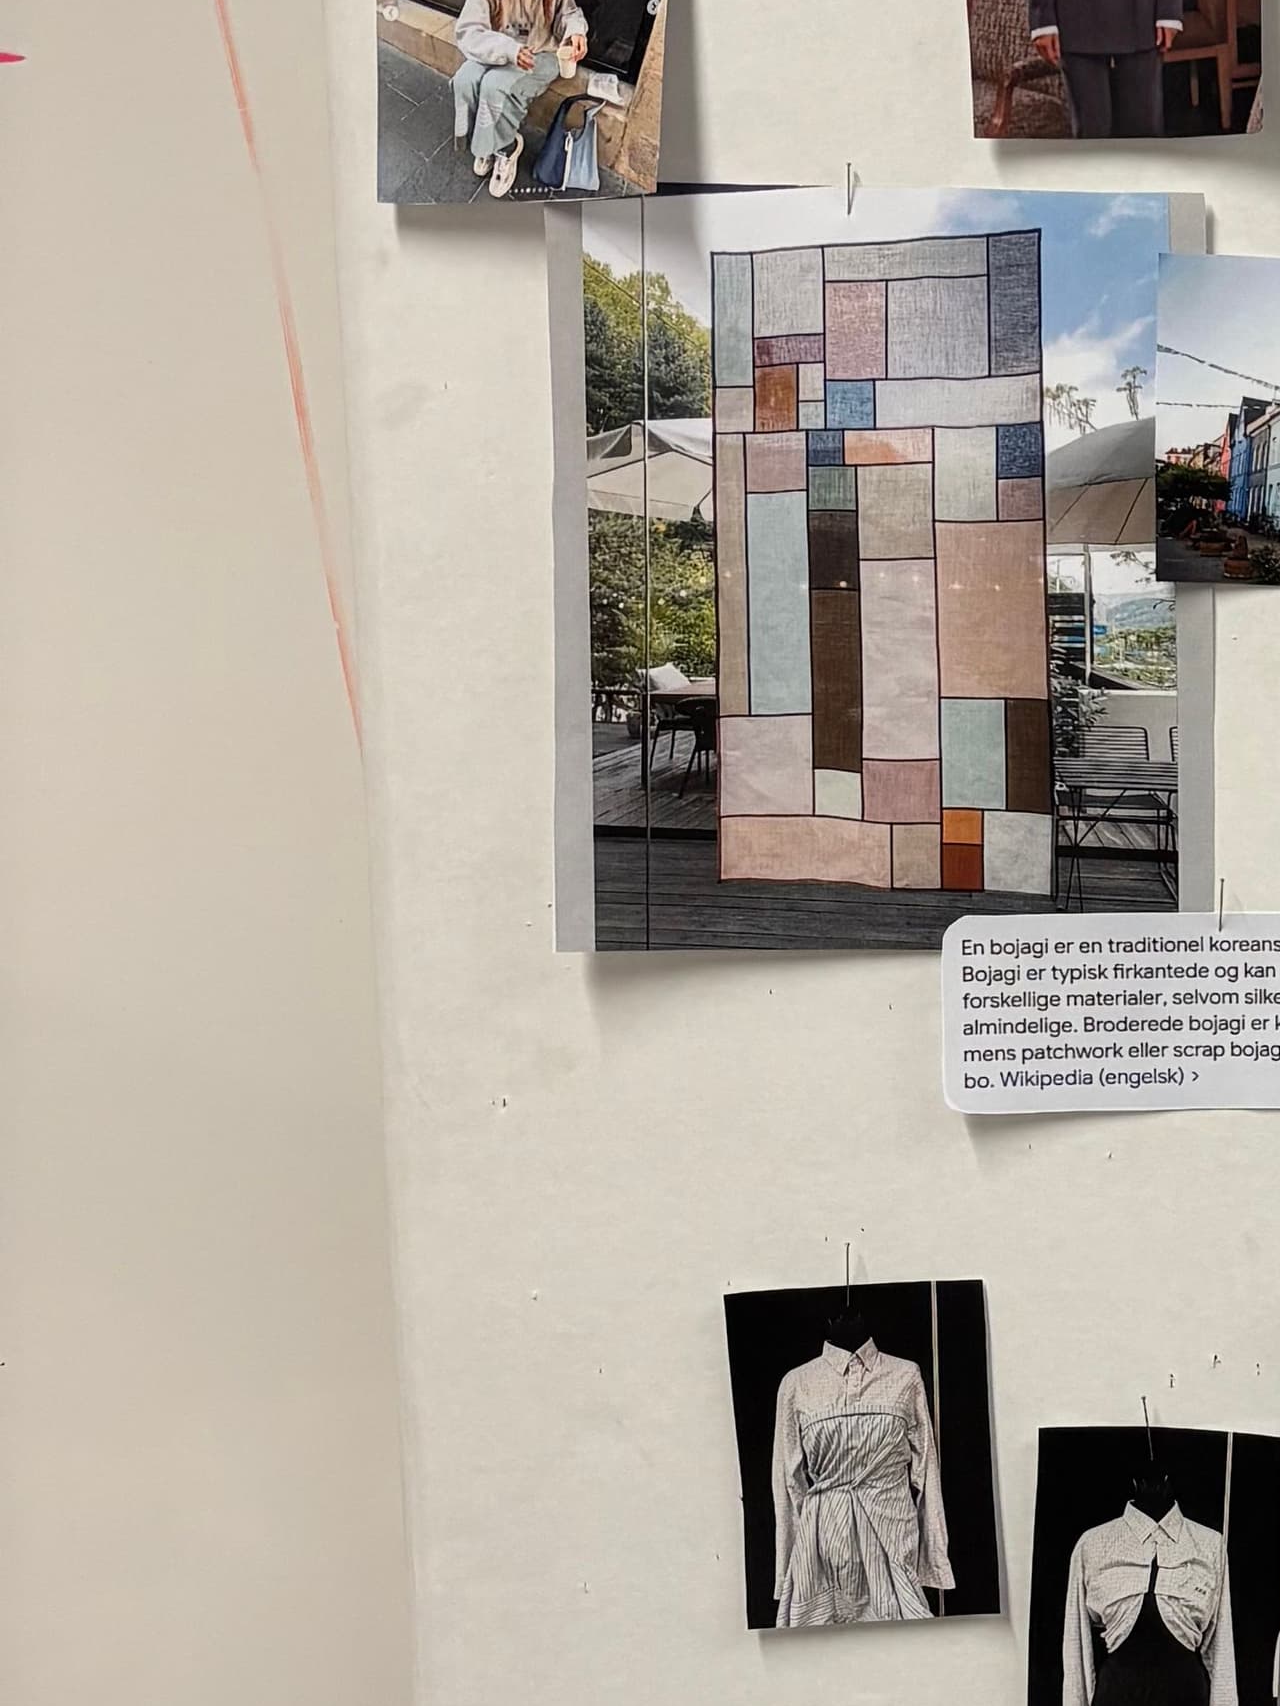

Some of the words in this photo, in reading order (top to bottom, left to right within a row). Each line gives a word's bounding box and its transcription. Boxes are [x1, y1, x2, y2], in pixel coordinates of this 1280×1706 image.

[962, 939, 985, 957] En
[990, 937, 1049, 960] bojagi
[1054, 941, 1076, 955] er
[1078, 941, 1103, 955] en
[1107, 935, 1205, 954] traditionel
[962, 964, 1021, 987] Bojagi
[1026, 968, 1048, 982] er
[1050, 963, 1110, 986] typisk
[1112, 962, 1210, 980] firkantede
[1214, 965, 1240, 984] og
[1244, 961, 1277, 979] kan
[962, 991, 1062, 1012] forskellige
[1066, 989, 1168, 1008] materialer,
[1172, 988, 1240, 1006] selvom
[963, 1016, 1079, 1039] almindelige.
[1083, 1015, 1184, 1034] Broderede
[1189, 1014, 1247, 1036] bojagi
[1250, 1018, 1271, 1032] er
[964, 1072, 996, 1090] bo.
[999, 1068, 1094, 1092] Wikipedia
[1099, 1066, 1185, 1090] (engelsk)
